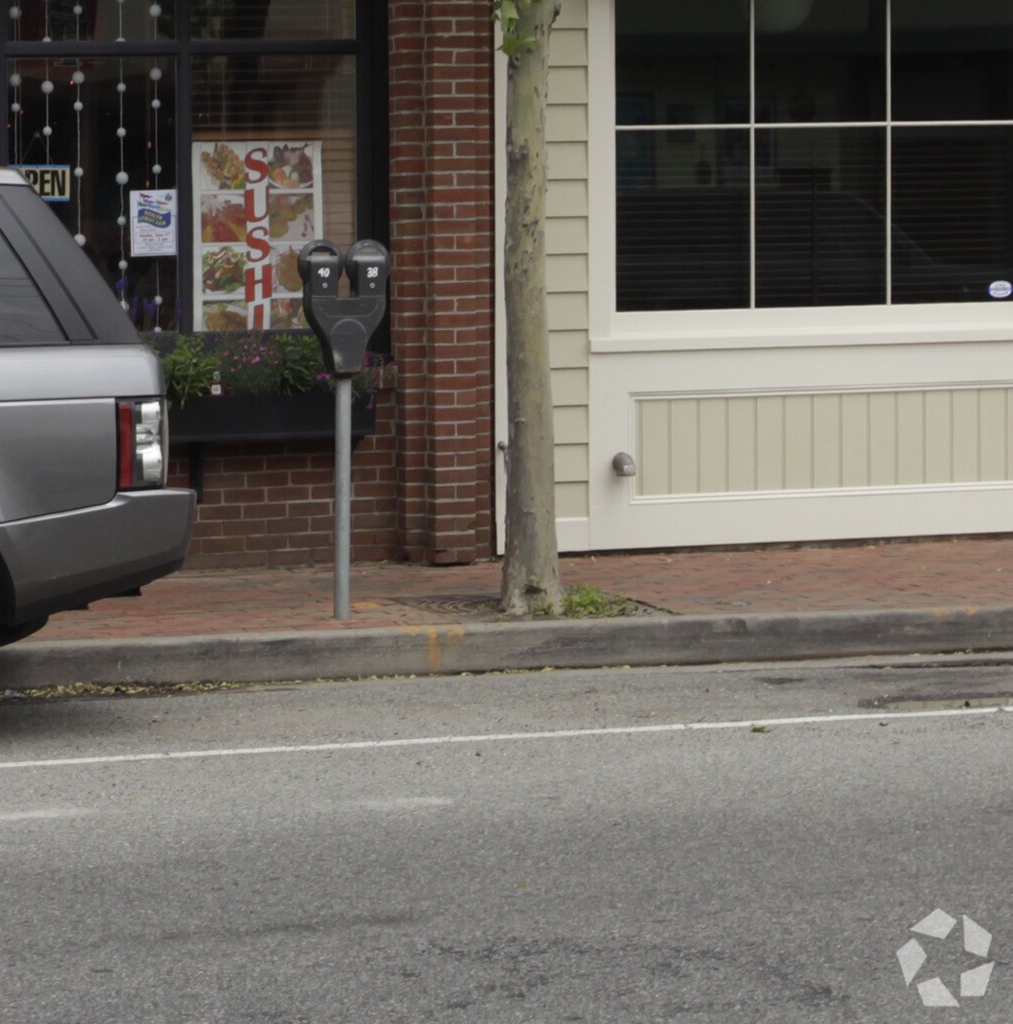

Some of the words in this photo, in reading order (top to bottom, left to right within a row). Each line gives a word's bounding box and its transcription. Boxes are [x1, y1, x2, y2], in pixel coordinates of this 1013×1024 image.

[24, 170, 66, 196] PEN
[244, 147, 272, 330] SUSHI
[367, 266, 379, 278] 38
